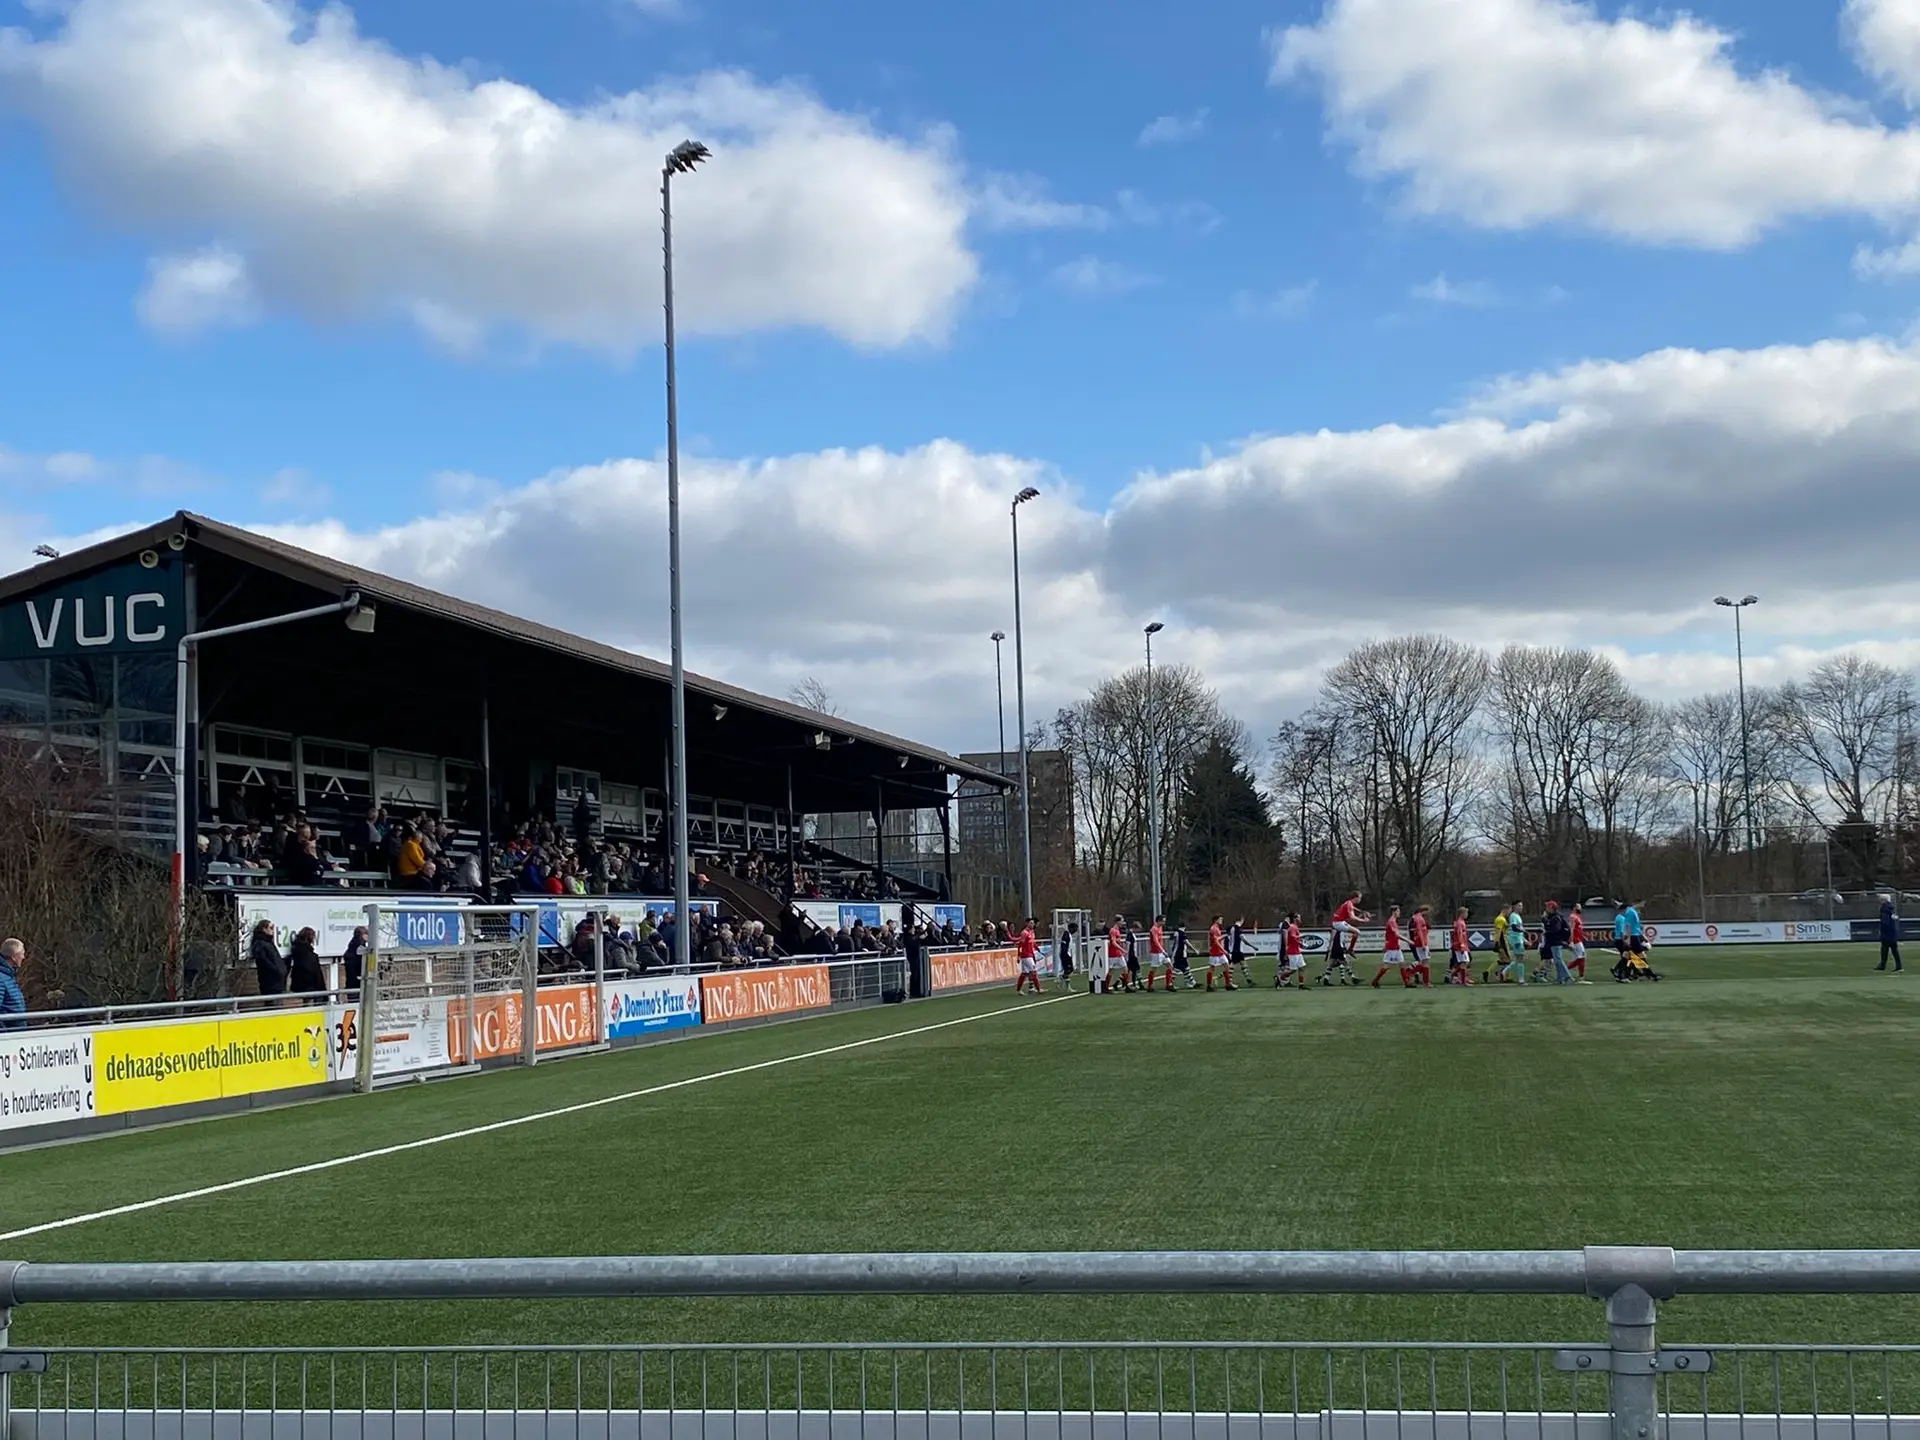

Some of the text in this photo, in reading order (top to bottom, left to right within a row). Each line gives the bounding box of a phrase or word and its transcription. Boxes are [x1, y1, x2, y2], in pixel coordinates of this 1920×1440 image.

[25, 592, 165, 648] VUC
[407, 912, 446, 941] hallo
[1796, 923, 1832, 934] Smits
[624, 987, 684, 1018] Domino's Pizza
[705, 985, 733, 1020] ING
[752, 981, 777, 1013] ING
[794, 976, 816, 1006] ING
[453, 1009, 500, 1057] ING
[537, 1001, 577, 1044] ING
[19, 1042, 79, 1071] Schilderwerk
[106, 1035, 300, 1081] dehaagsevoetbalhistorie.nl
[12, 1085, 80, 1112] houtbewerking
